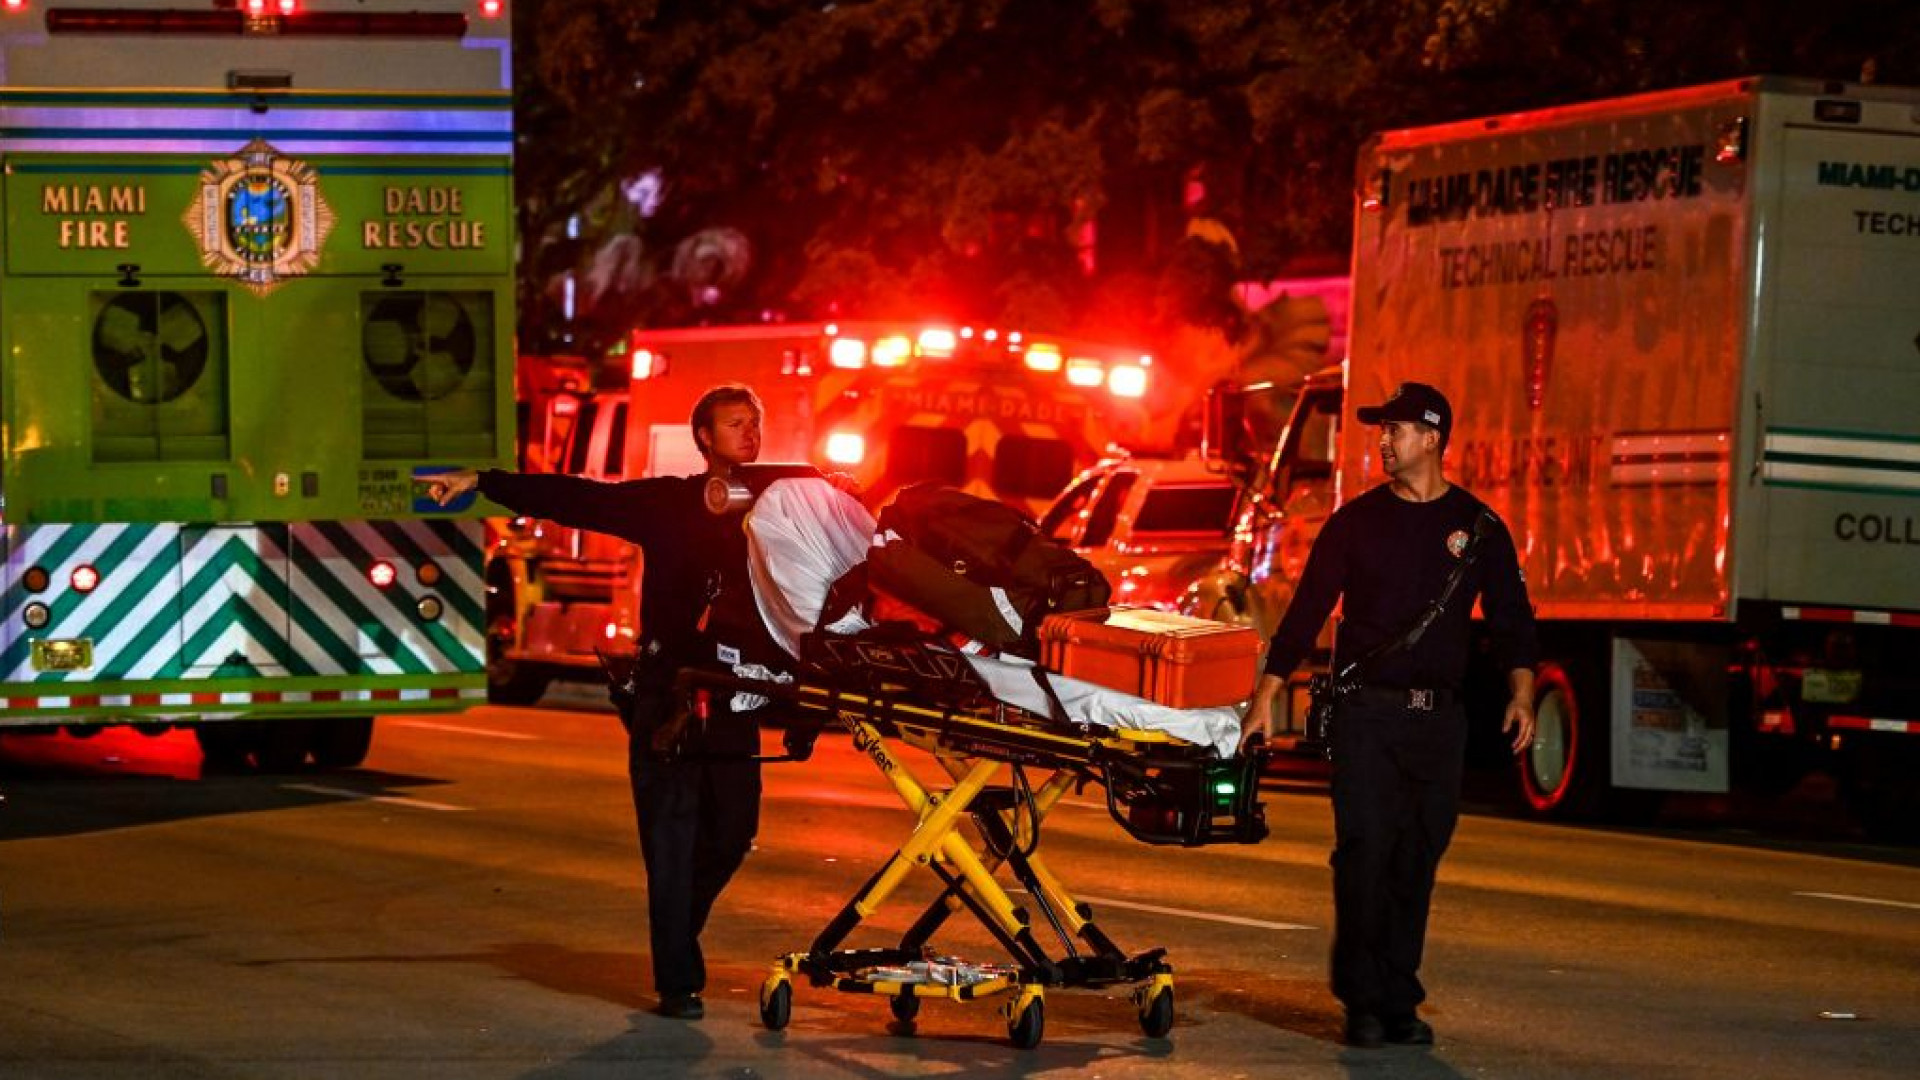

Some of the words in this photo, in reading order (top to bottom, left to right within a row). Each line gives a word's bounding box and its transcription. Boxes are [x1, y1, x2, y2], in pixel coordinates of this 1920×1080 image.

[1545, 156, 1599, 211] FIRE
[1603, 145, 1704, 205] RESCUE
[43, 185, 146, 214] MIAMI
[384, 186, 462, 215] DADE
[59, 220, 130, 249] FIRE
[363, 220, 485, 249] RESCUE
[1853, 210, 1920, 236] TECH
[1440, 237, 1557, 290] TECHNICAL
[1564, 225, 1657, 278] RESCUE
[1835, 511, 1920, 545] COLL
